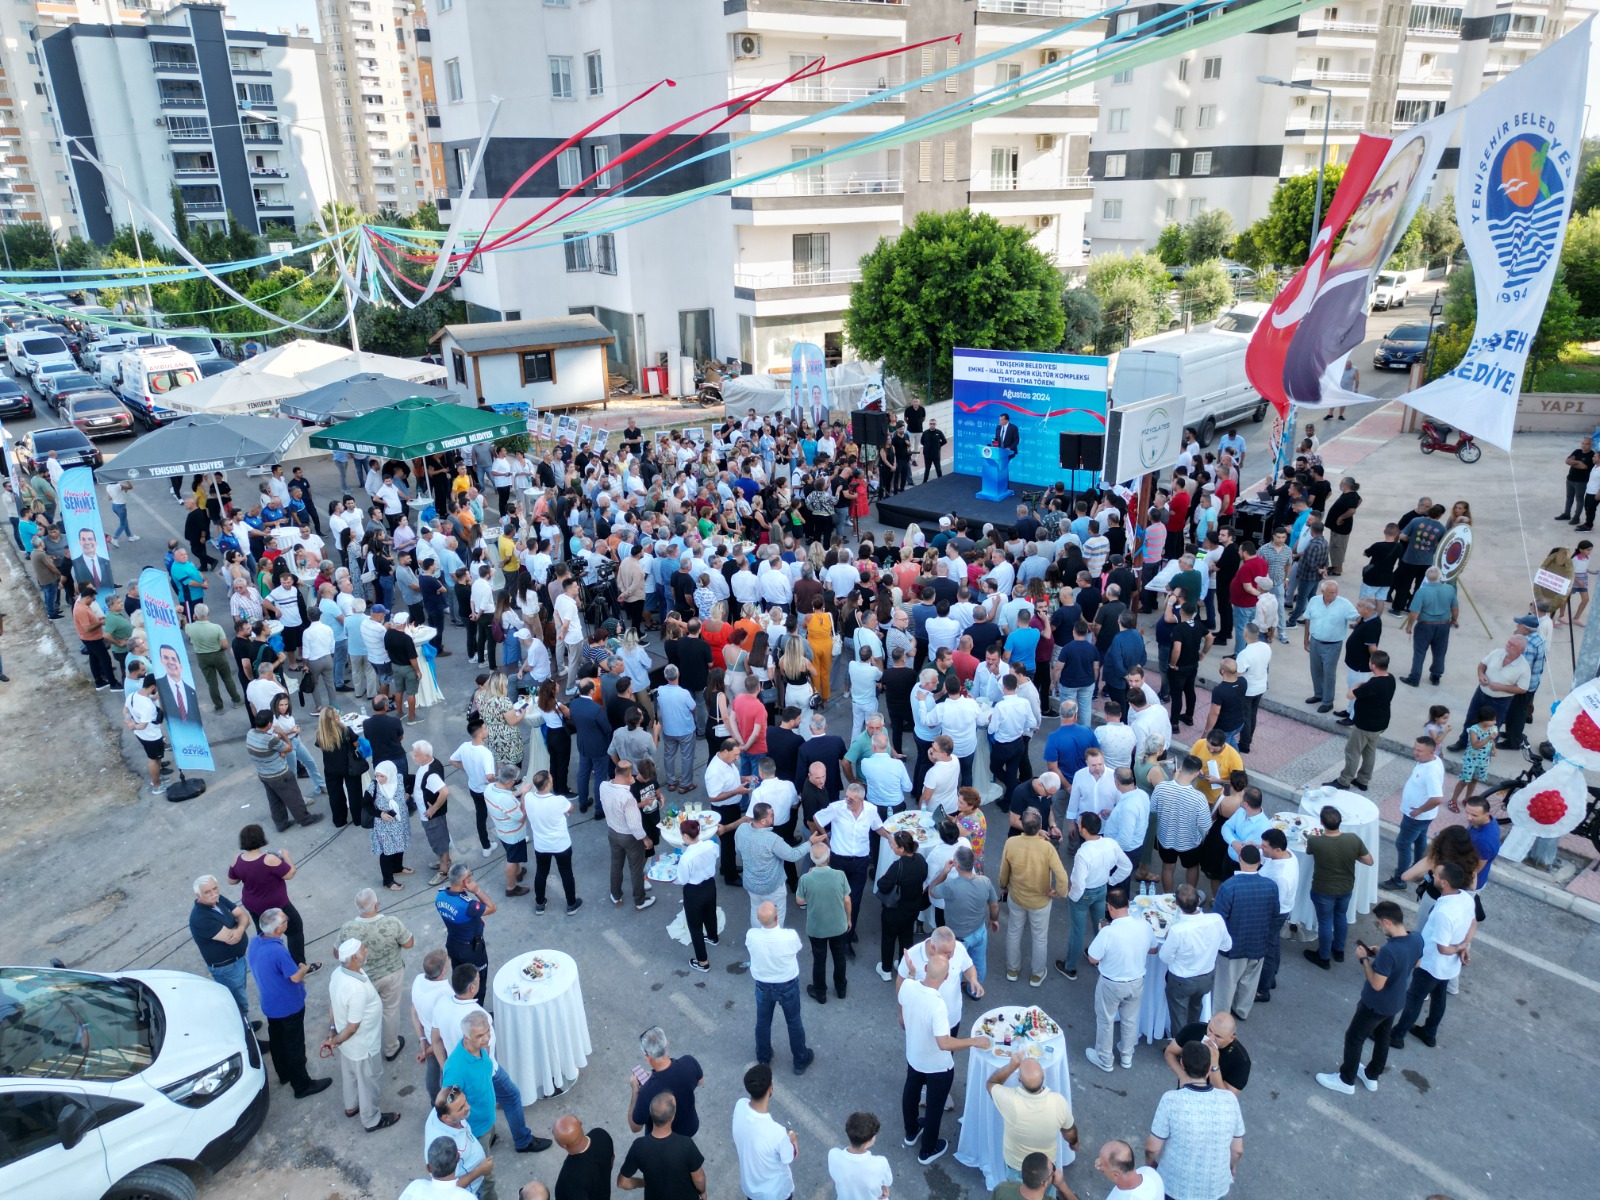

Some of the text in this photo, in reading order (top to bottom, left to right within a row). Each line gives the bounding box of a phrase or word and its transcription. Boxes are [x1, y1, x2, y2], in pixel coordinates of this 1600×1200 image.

[1472, 121, 1509, 224] YENİŞEHİR
[996, 360, 1058, 370] YENİŞEHİR BELEDİYESİ
[998, 376, 1056, 386] TEMEL ATMA TÖRENİ
[1032, 370, 1054, 378] KÜLTÜR
[1055, 372, 1090, 381] KOMPLEKSİ
[1002, 389, 1051, 401] Ağustos 2024
[1541, 400, 1585, 412] YAPI
